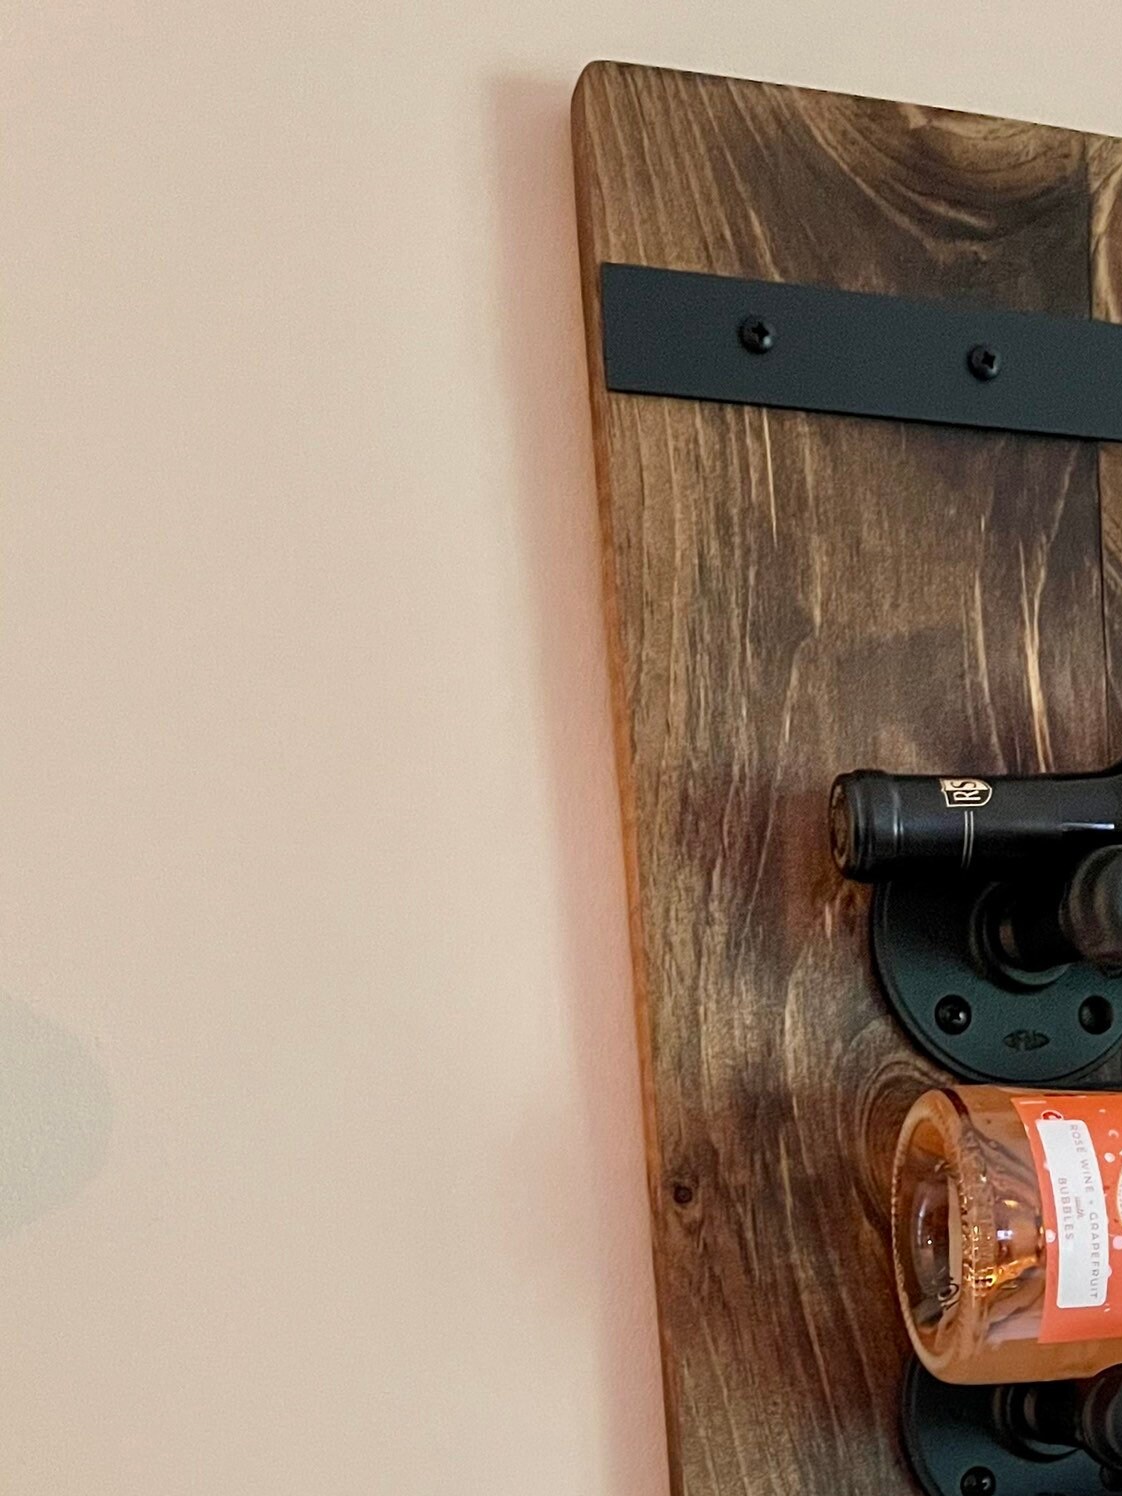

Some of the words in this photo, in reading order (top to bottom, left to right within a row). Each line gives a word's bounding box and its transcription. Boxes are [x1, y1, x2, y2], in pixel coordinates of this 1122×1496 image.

[952, 780, 982, 802] RS
[1058, 1178, 1074, 1240] BUBBLES
[1079, 1158, 1094, 1193] WINE
[1089, 1212, 1100, 1298] GRAPEFRUIT
